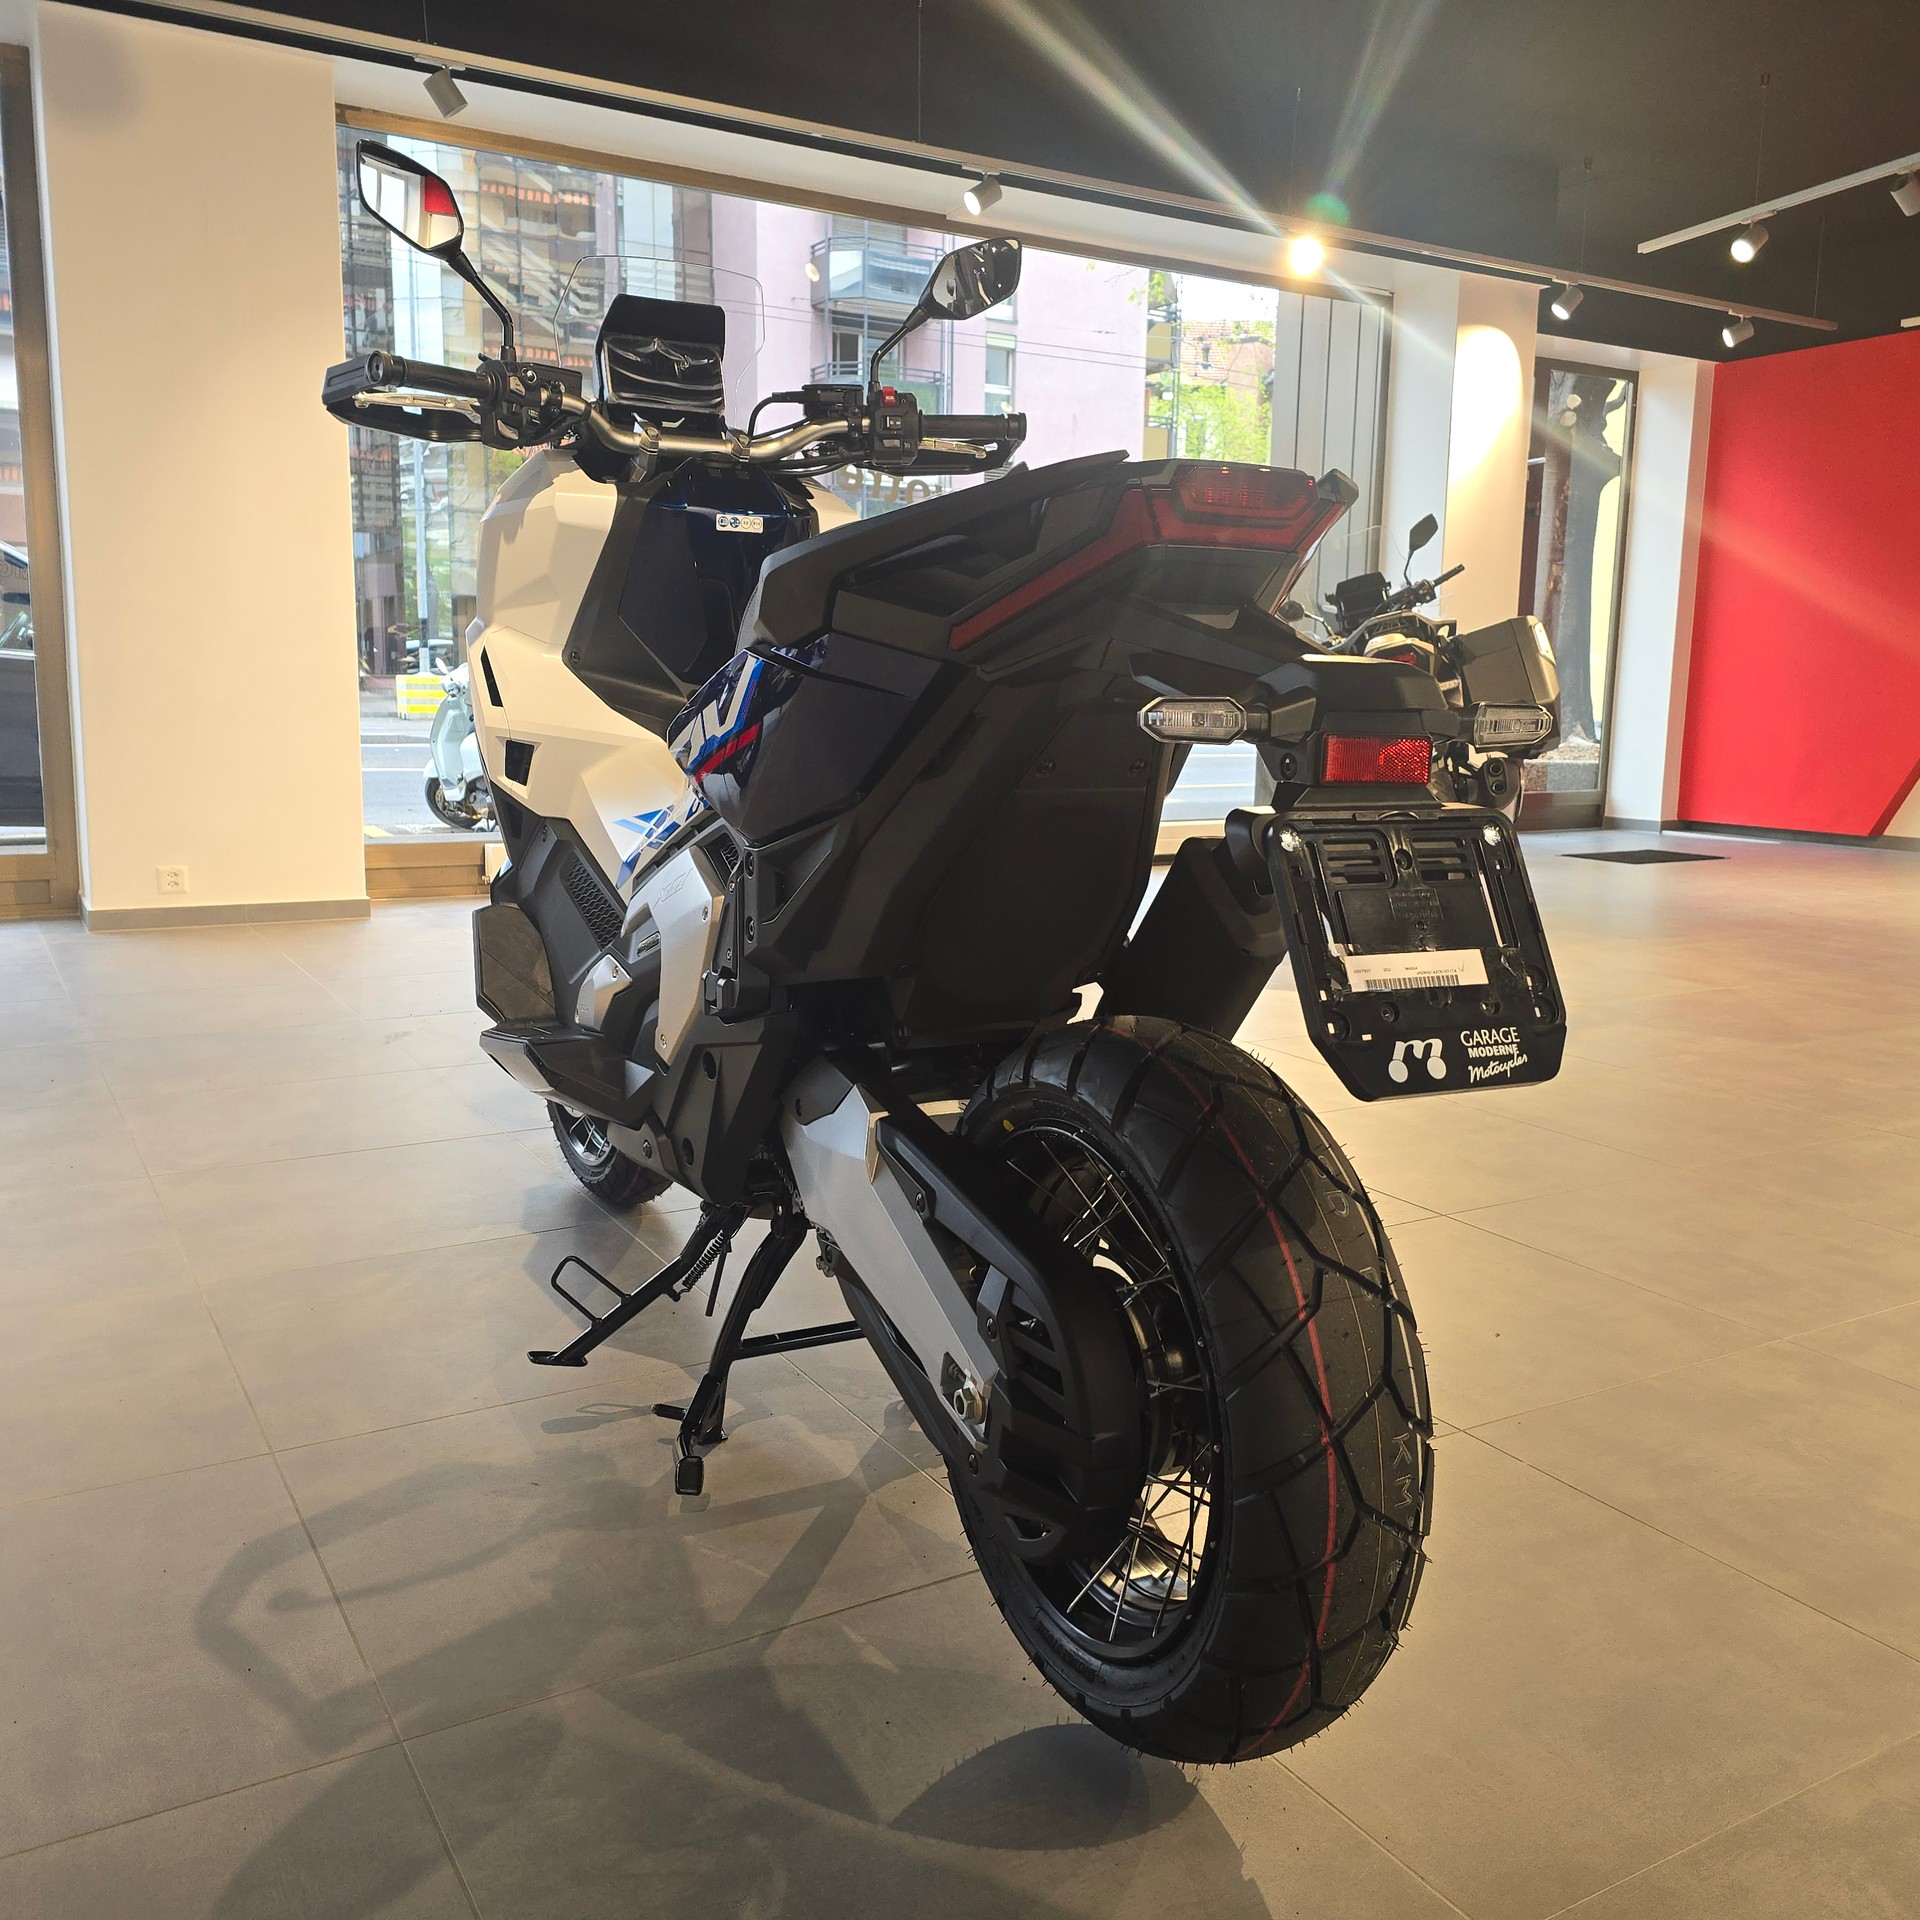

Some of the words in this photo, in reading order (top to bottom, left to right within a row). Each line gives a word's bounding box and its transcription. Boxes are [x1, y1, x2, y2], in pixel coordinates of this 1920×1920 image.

[1460, 1026, 1521, 1047] GARAGE
[1467, 1043, 1520, 1059] MODERNE
[1467, 1052, 1528, 1084] Motocycles
